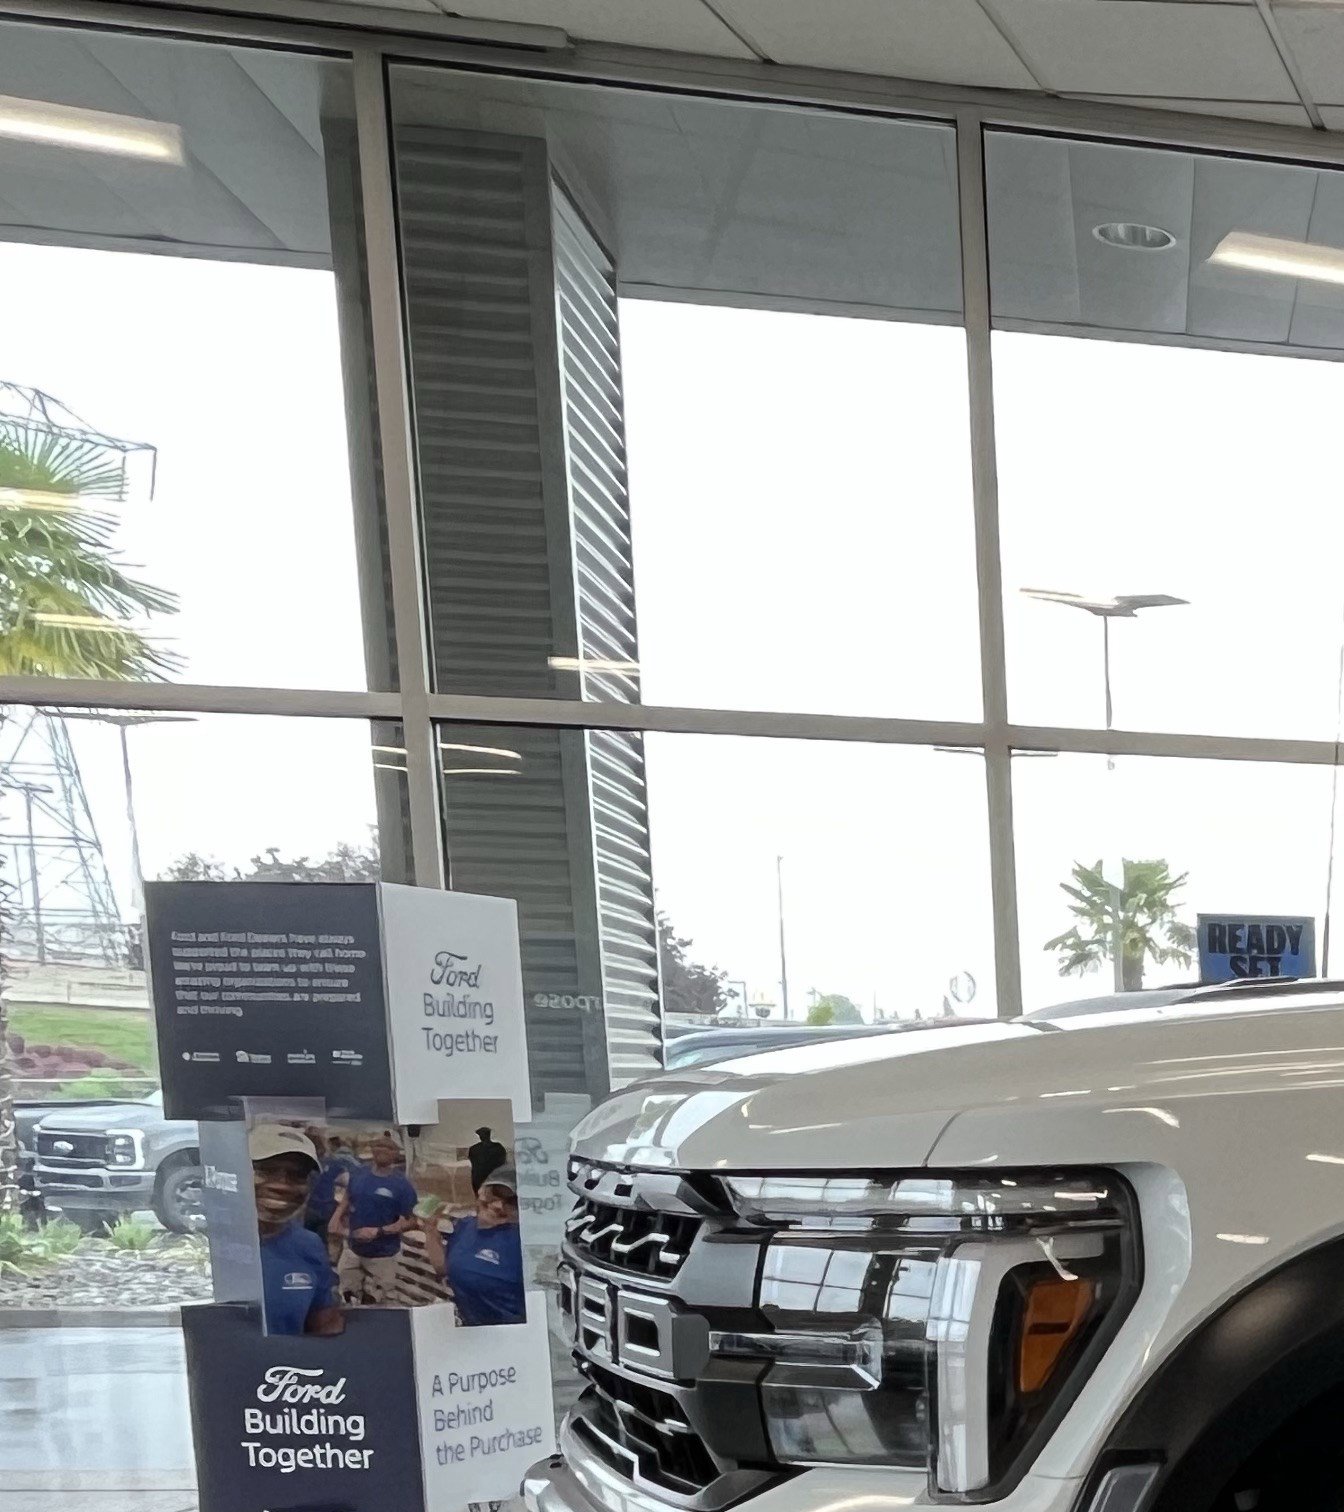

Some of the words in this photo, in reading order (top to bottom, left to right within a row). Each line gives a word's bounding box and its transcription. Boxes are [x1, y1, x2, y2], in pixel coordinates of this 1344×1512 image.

[1207, 922, 1303, 955] READY
[430, 951, 482, 988] Ford
[1229, 954, 1282, 979] SET
[423, 992, 494, 1026] Building
[421, 1027, 499, 1057] Together
[257, 1366, 346, 1404] Ford
[432, 1375, 444, 1398] A
[448, 1366, 517, 1394] Purpose
[244, 1407, 365, 1441] Building
[434, 1398, 494, 1432] Behind
[241, 1442, 375, 1474] Together
[436, 1441, 466, 1466] the
[470, 1426, 543, 1458] Purchase
